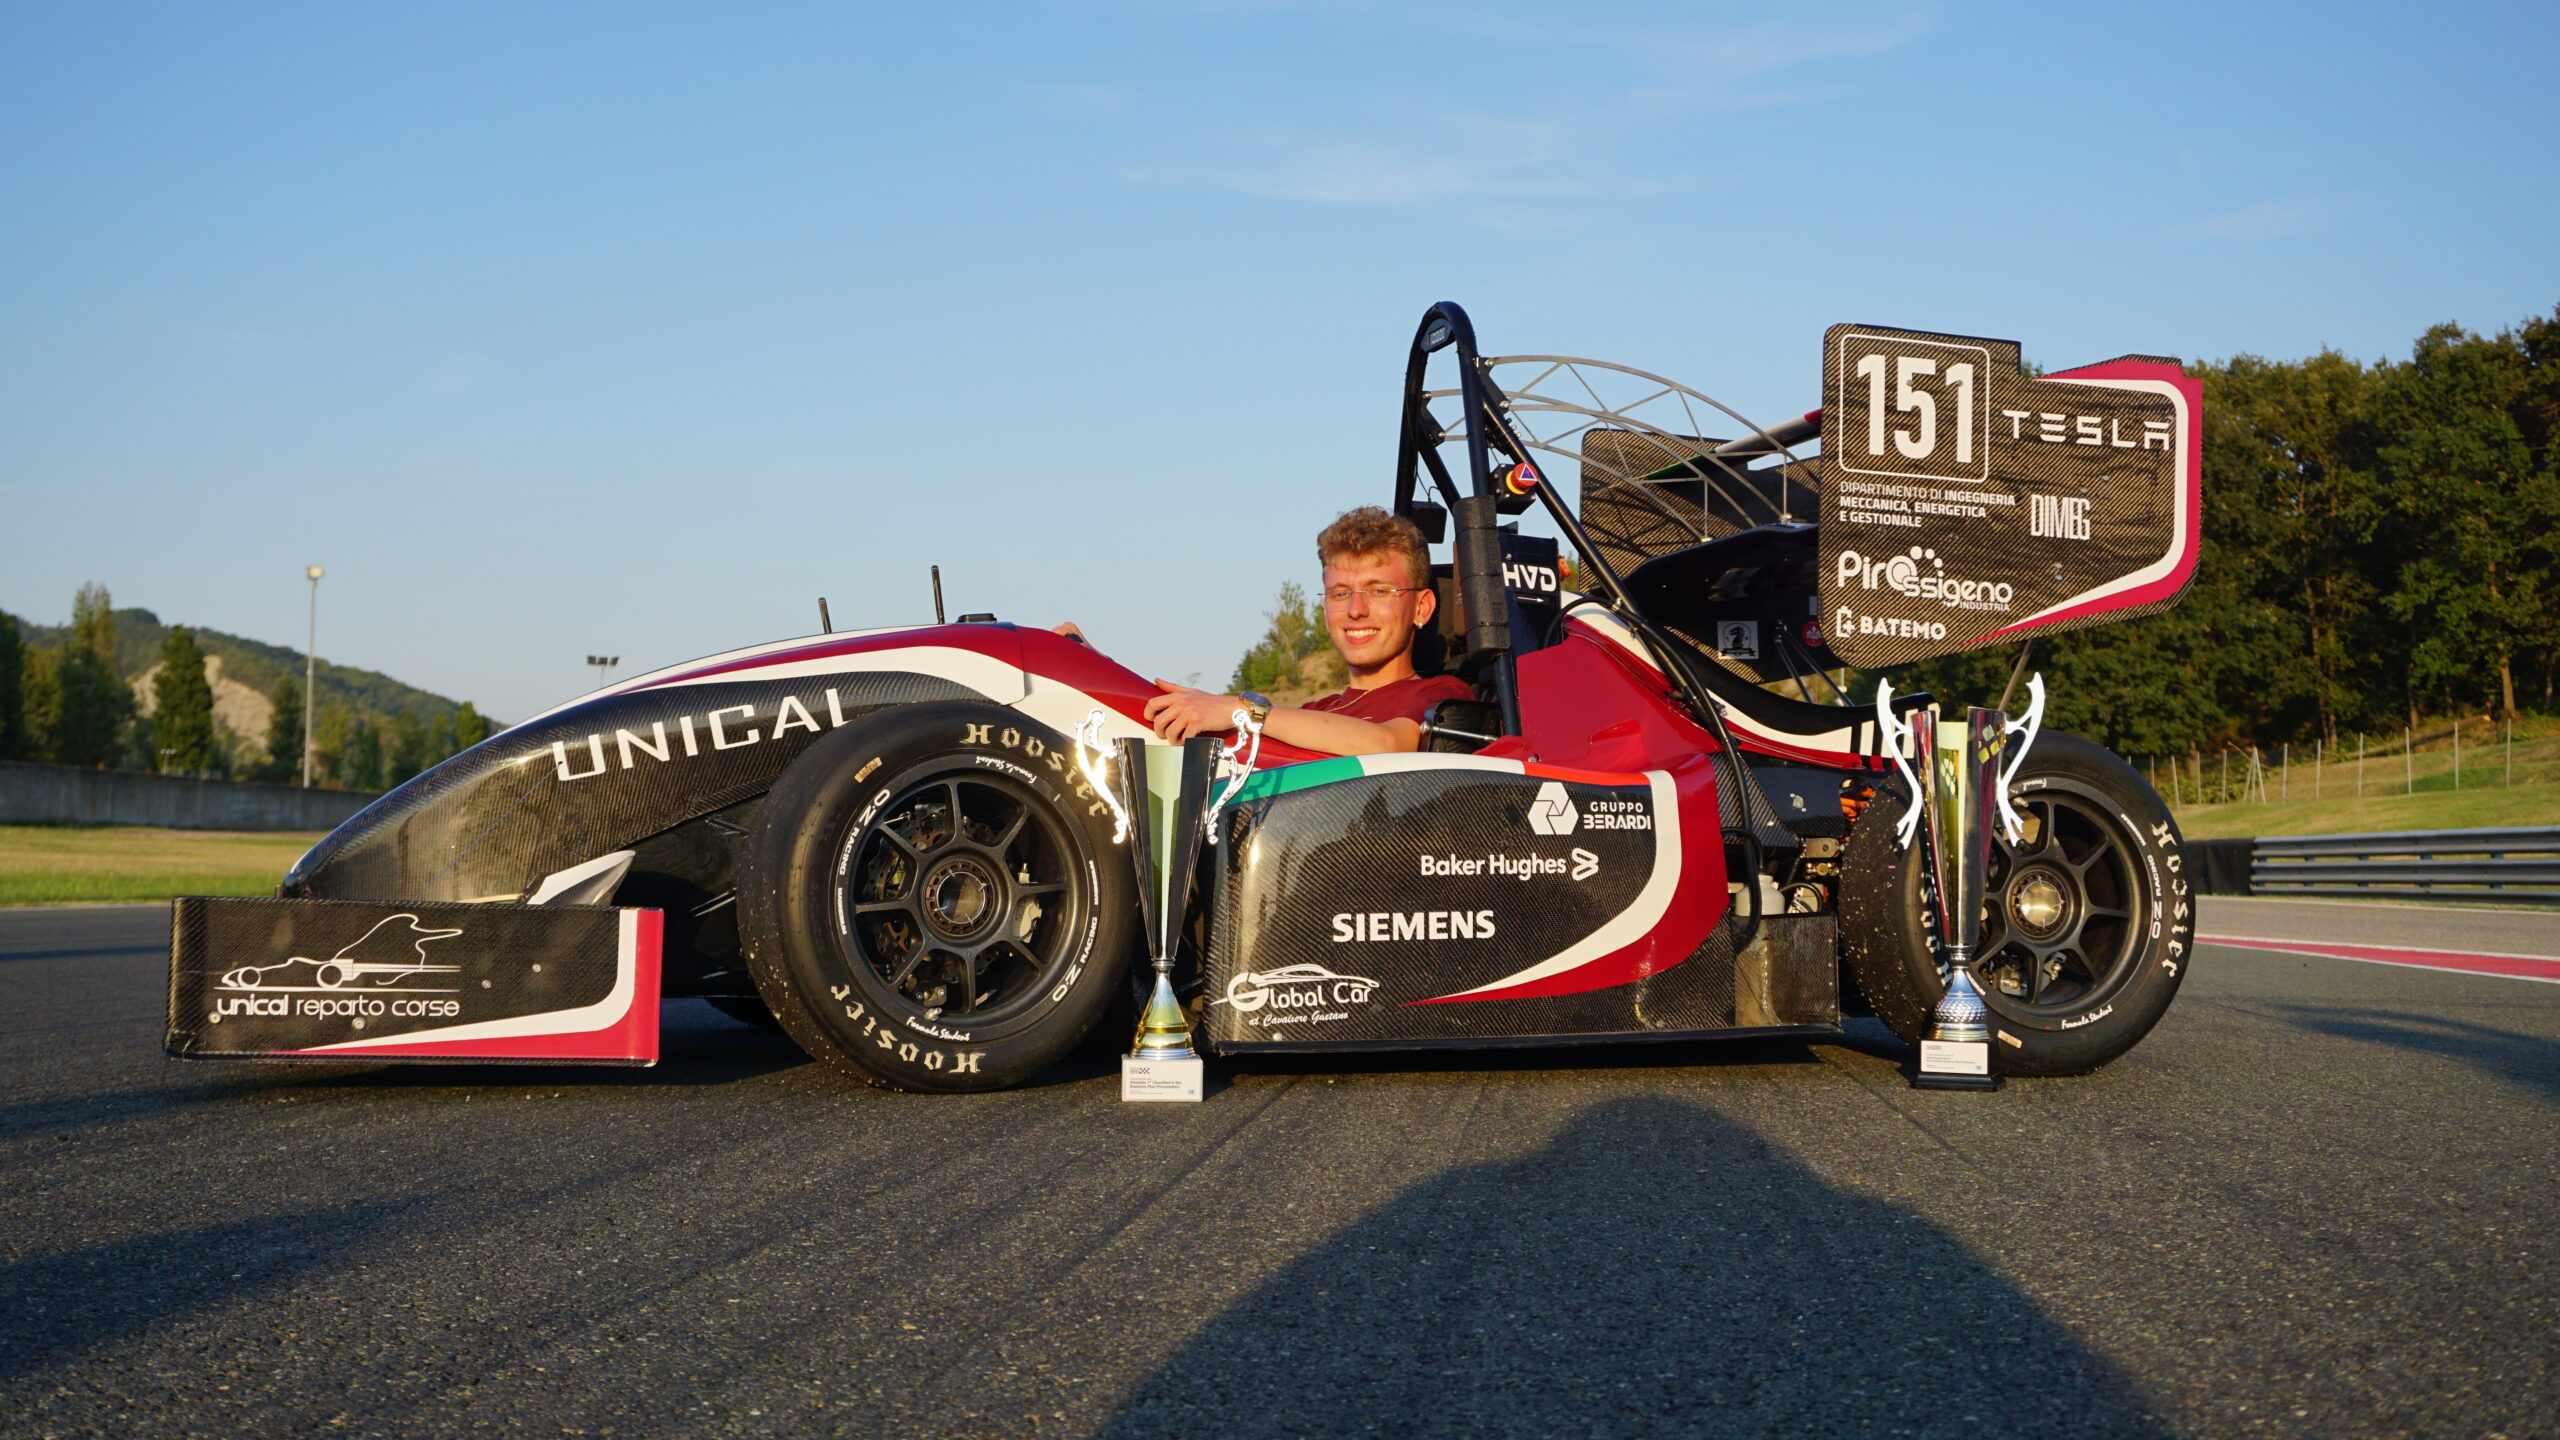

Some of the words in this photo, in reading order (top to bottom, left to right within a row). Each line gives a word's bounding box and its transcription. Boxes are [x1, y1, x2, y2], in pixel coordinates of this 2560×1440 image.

[1857, 354, 1974, 463] 151
[2002, 409, 2170, 450] TESLA
[1840, 481, 1927, 499] DIPARTIMENTO
[1930, 488, 1942, 499] DI
[1944, 490, 2016, 506] INGEGNERIA
[1840, 496, 1912, 514] MECCANICA,
[1914, 502, 1986, 518] ENERGETICA
[1839, 511, 1847, 522] E
[1850, 511, 1922, 528] GESTIONALE
[2031, 494, 2090, 540] DIMEG
[1502, 562, 1557, 592] HVD
[1959, 601, 2011, 612] INDUSTRIA
[1860, 616, 1947, 640] BATEMO
[552, 688, 853, 781] UNICAL
[1583, 814, 1651, 830] BERARDI
[1590, 801, 1644, 813] GRUPPO
[839, 827, 860, 876] RACING
[1420, 853, 1485, 876] Baker
[1489, 853, 1567, 881] Hughes
[2147, 854, 2162, 897] RACING
[2151, 820, 2189, 978] Hoosier
[1080, 916, 1098, 963] RACING
[1332, 910, 1496, 942] SIEMENS
[217, 993, 289, 1016] unical
[296, 995, 385, 1020] reparto
[391, 1000, 460, 1017] corse
[1227, 972, 1326, 1012] Global
[1334, 982, 1372, 1004] Car
[831, 984, 987, 1073] Hoosier
[906, 1016, 939, 1036] Formula
[939, 1028, 971, 1042] Student
[1263, 1014, 1308, 1027] Cavaliere
[1311, 1010, 1349, 1025] Gaetano
